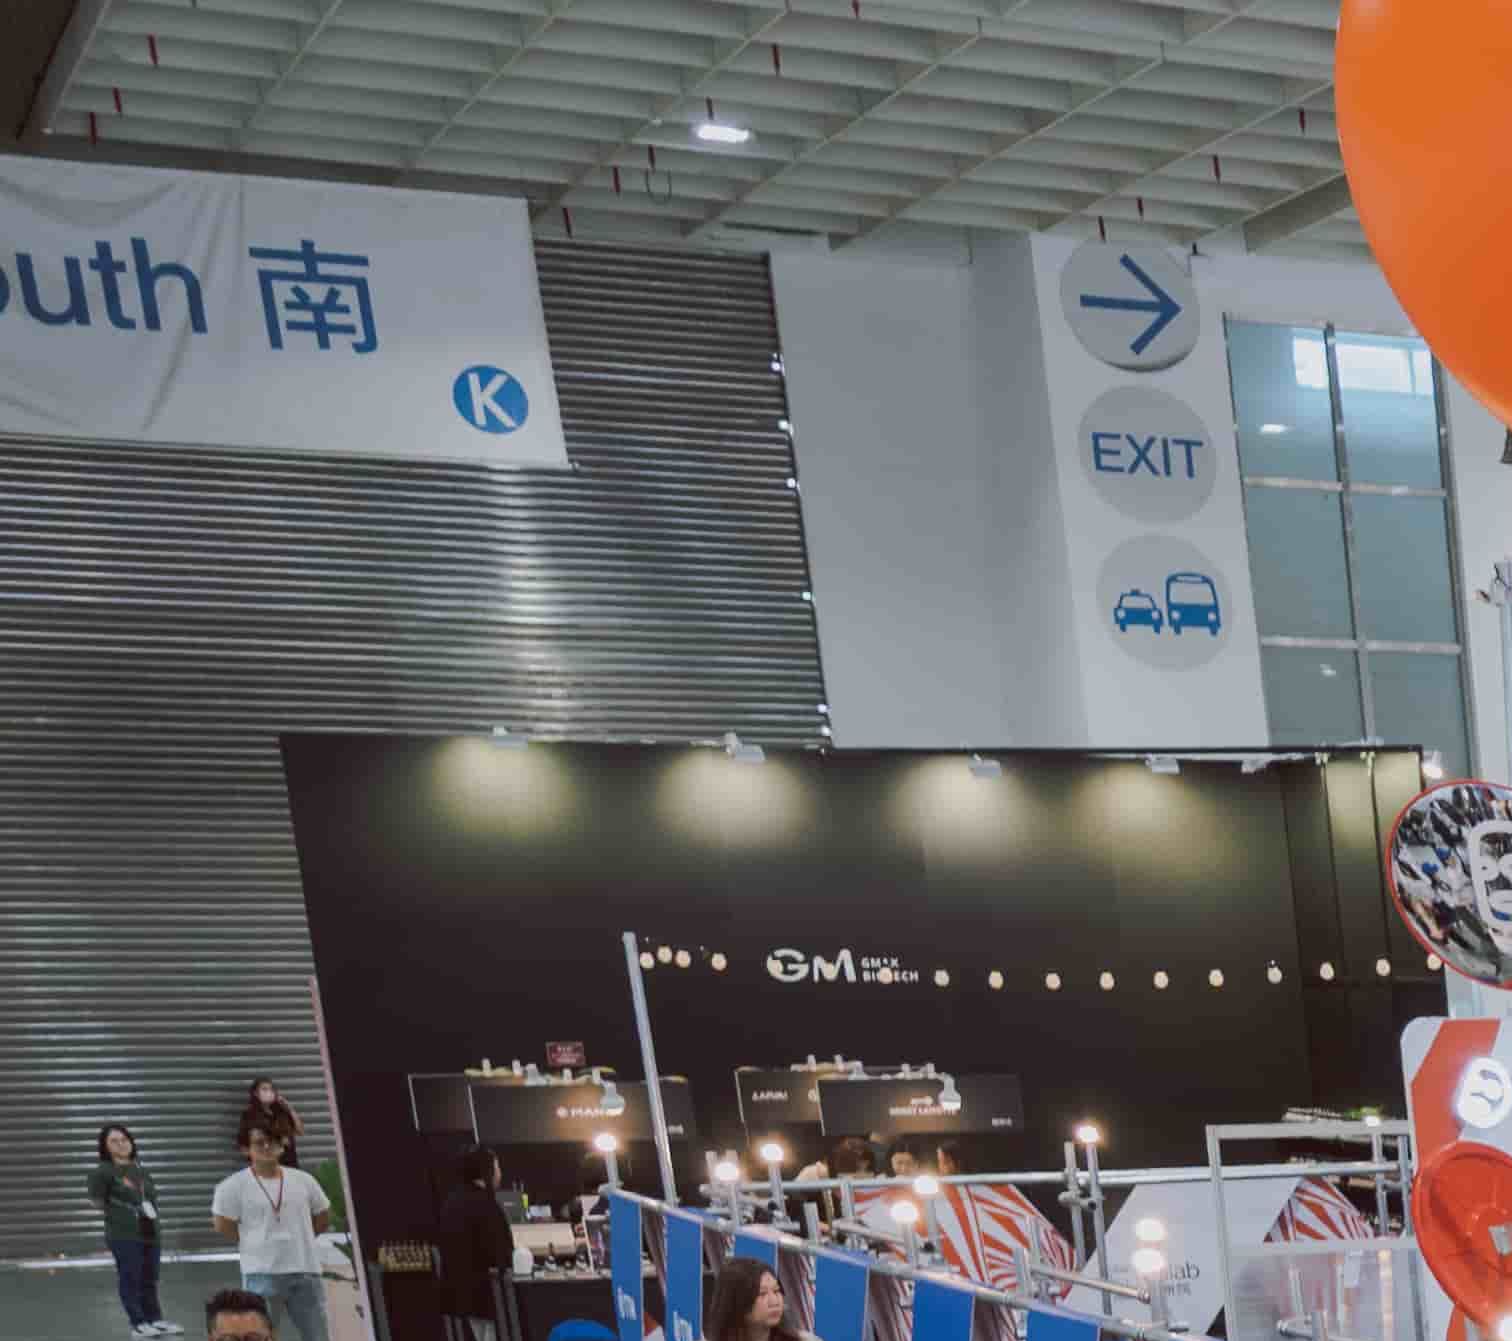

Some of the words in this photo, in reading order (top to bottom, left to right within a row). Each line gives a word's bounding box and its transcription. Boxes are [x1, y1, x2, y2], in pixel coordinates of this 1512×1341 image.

[248, 240, 380, 354] 南
[1090, 431, 1204, 482] EXIT
[766, 948, 857, 983] GM
